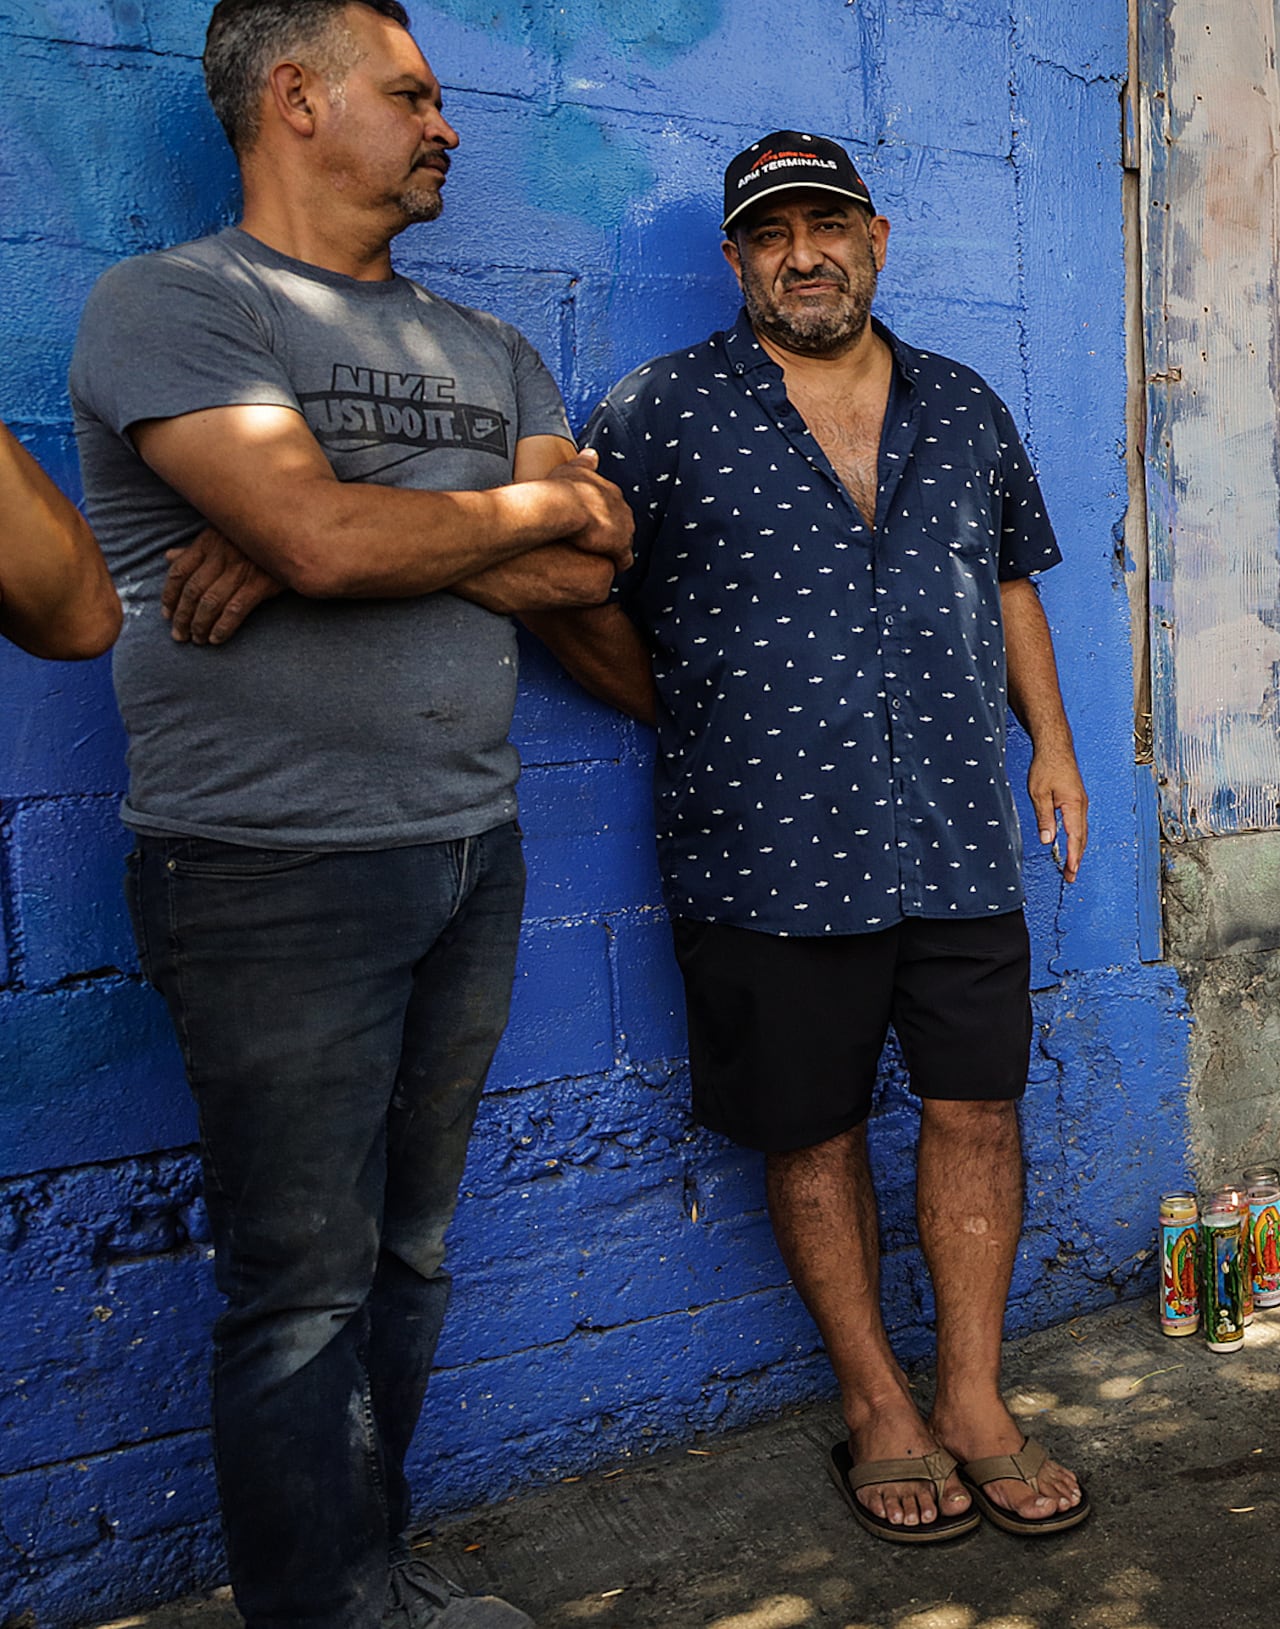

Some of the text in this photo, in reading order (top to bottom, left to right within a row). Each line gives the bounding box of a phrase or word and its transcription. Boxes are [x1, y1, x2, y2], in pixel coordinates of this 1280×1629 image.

[761, 158, 838, 174] TERMINALS
[332, 364, 456, 402] NIKE
[379, 403, 423, 439] DO
